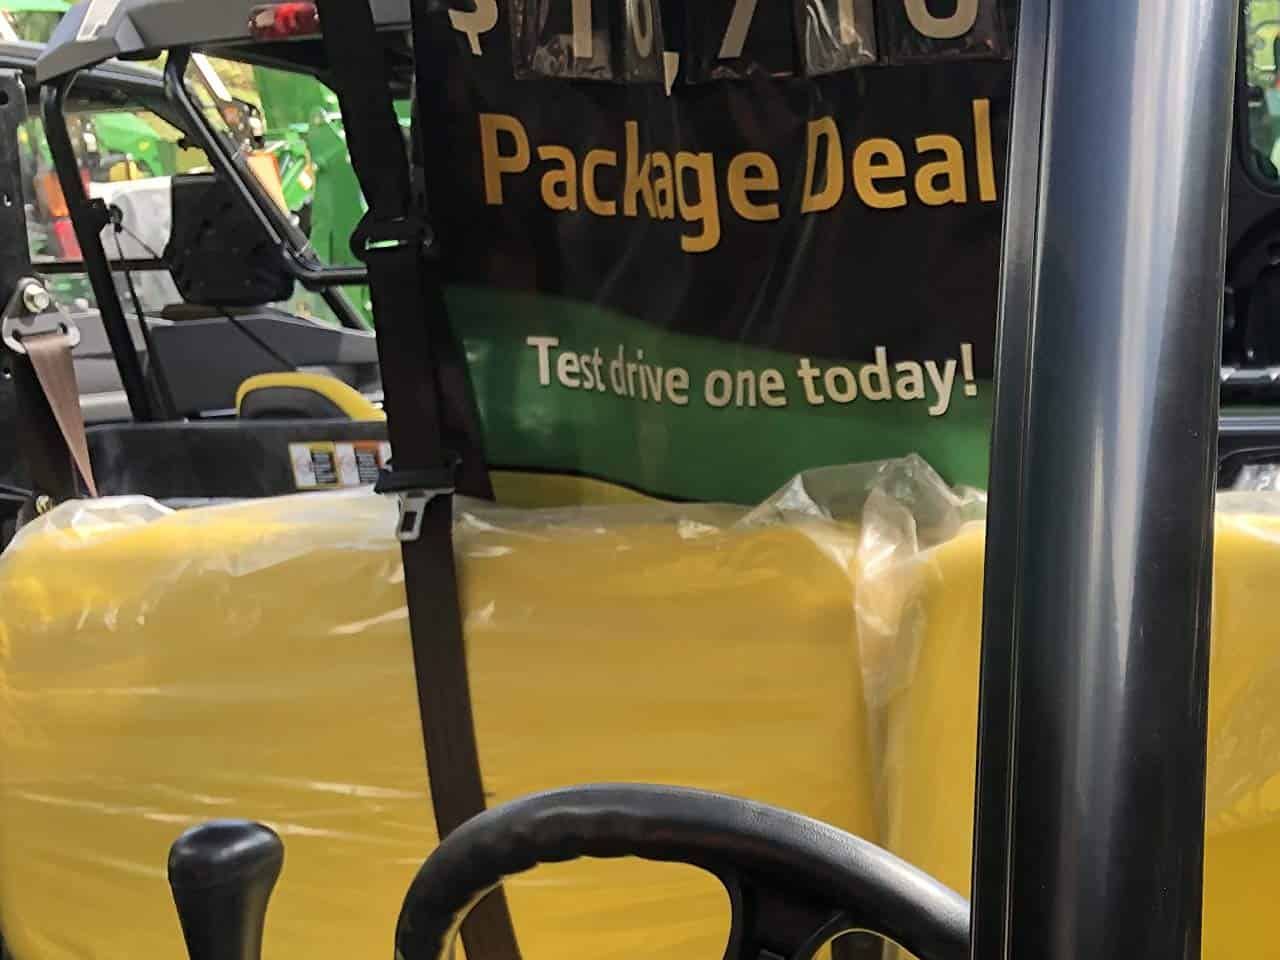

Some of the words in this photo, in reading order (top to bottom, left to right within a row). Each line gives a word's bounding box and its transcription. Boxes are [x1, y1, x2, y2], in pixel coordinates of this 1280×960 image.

[479, 112, 781, 253] Package
[801, 98, 997, 214] Deal
[527, 336, 607, 392] Test
[609, 345, 690, 405] drive
[704, 367, 787, 407] one
[797, 343, 978, 416] today!
